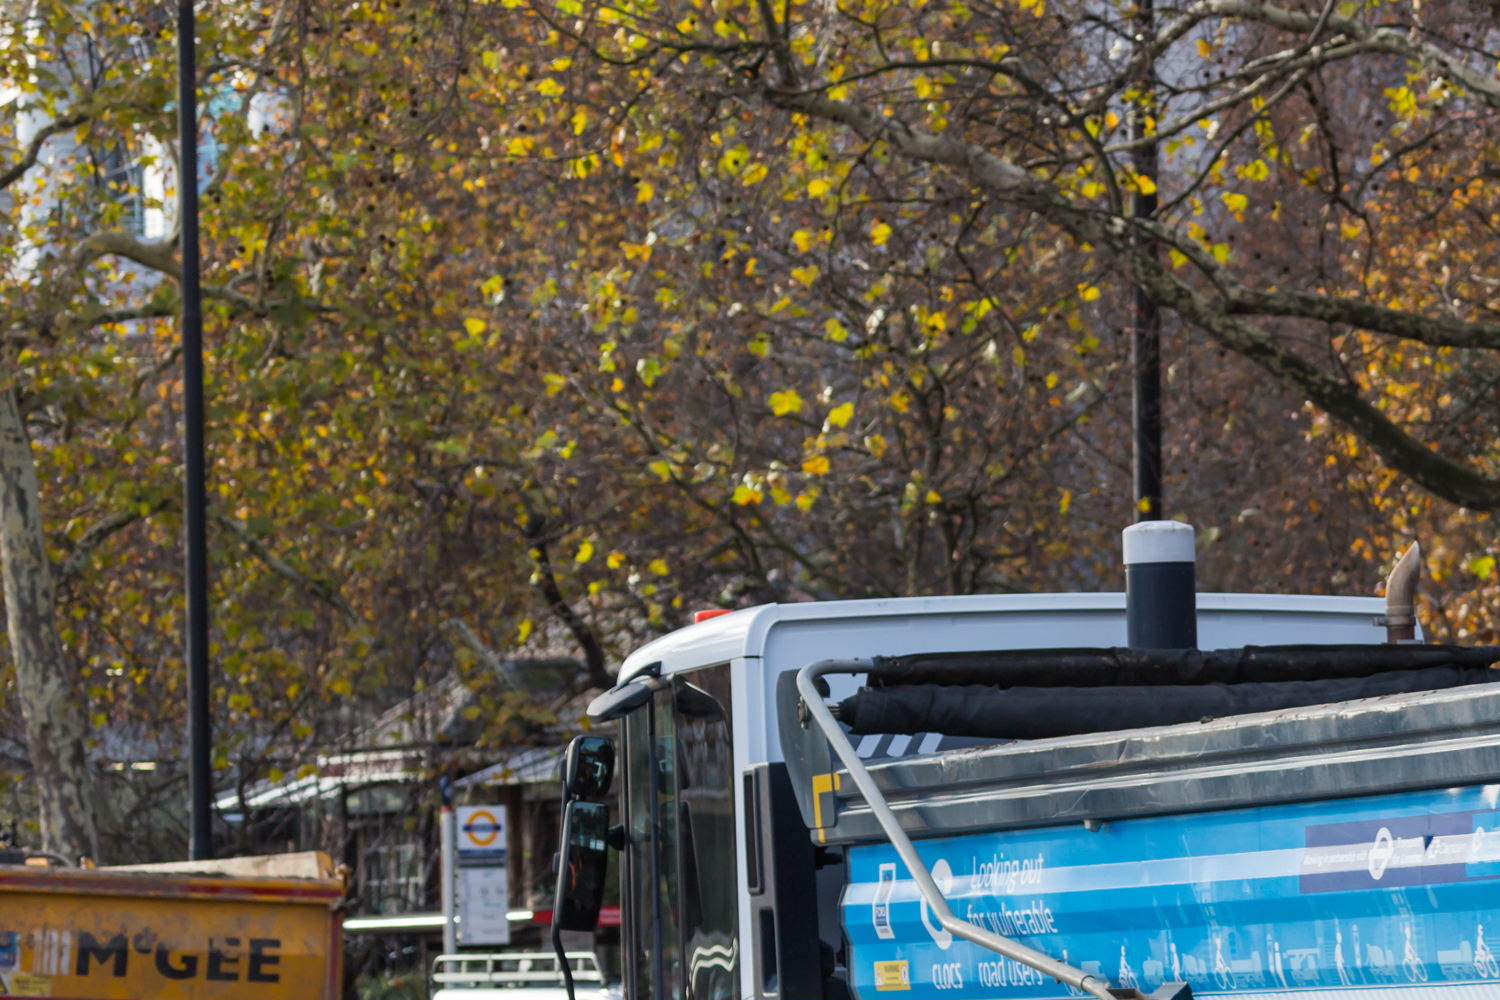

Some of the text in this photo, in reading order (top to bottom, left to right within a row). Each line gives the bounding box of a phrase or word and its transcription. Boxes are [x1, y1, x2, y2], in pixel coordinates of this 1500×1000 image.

[970, 853, 1044, 894] Looking out
[967, 899, 1058, 936] for vulnerable
[978, 954, 1043, 988] road users
